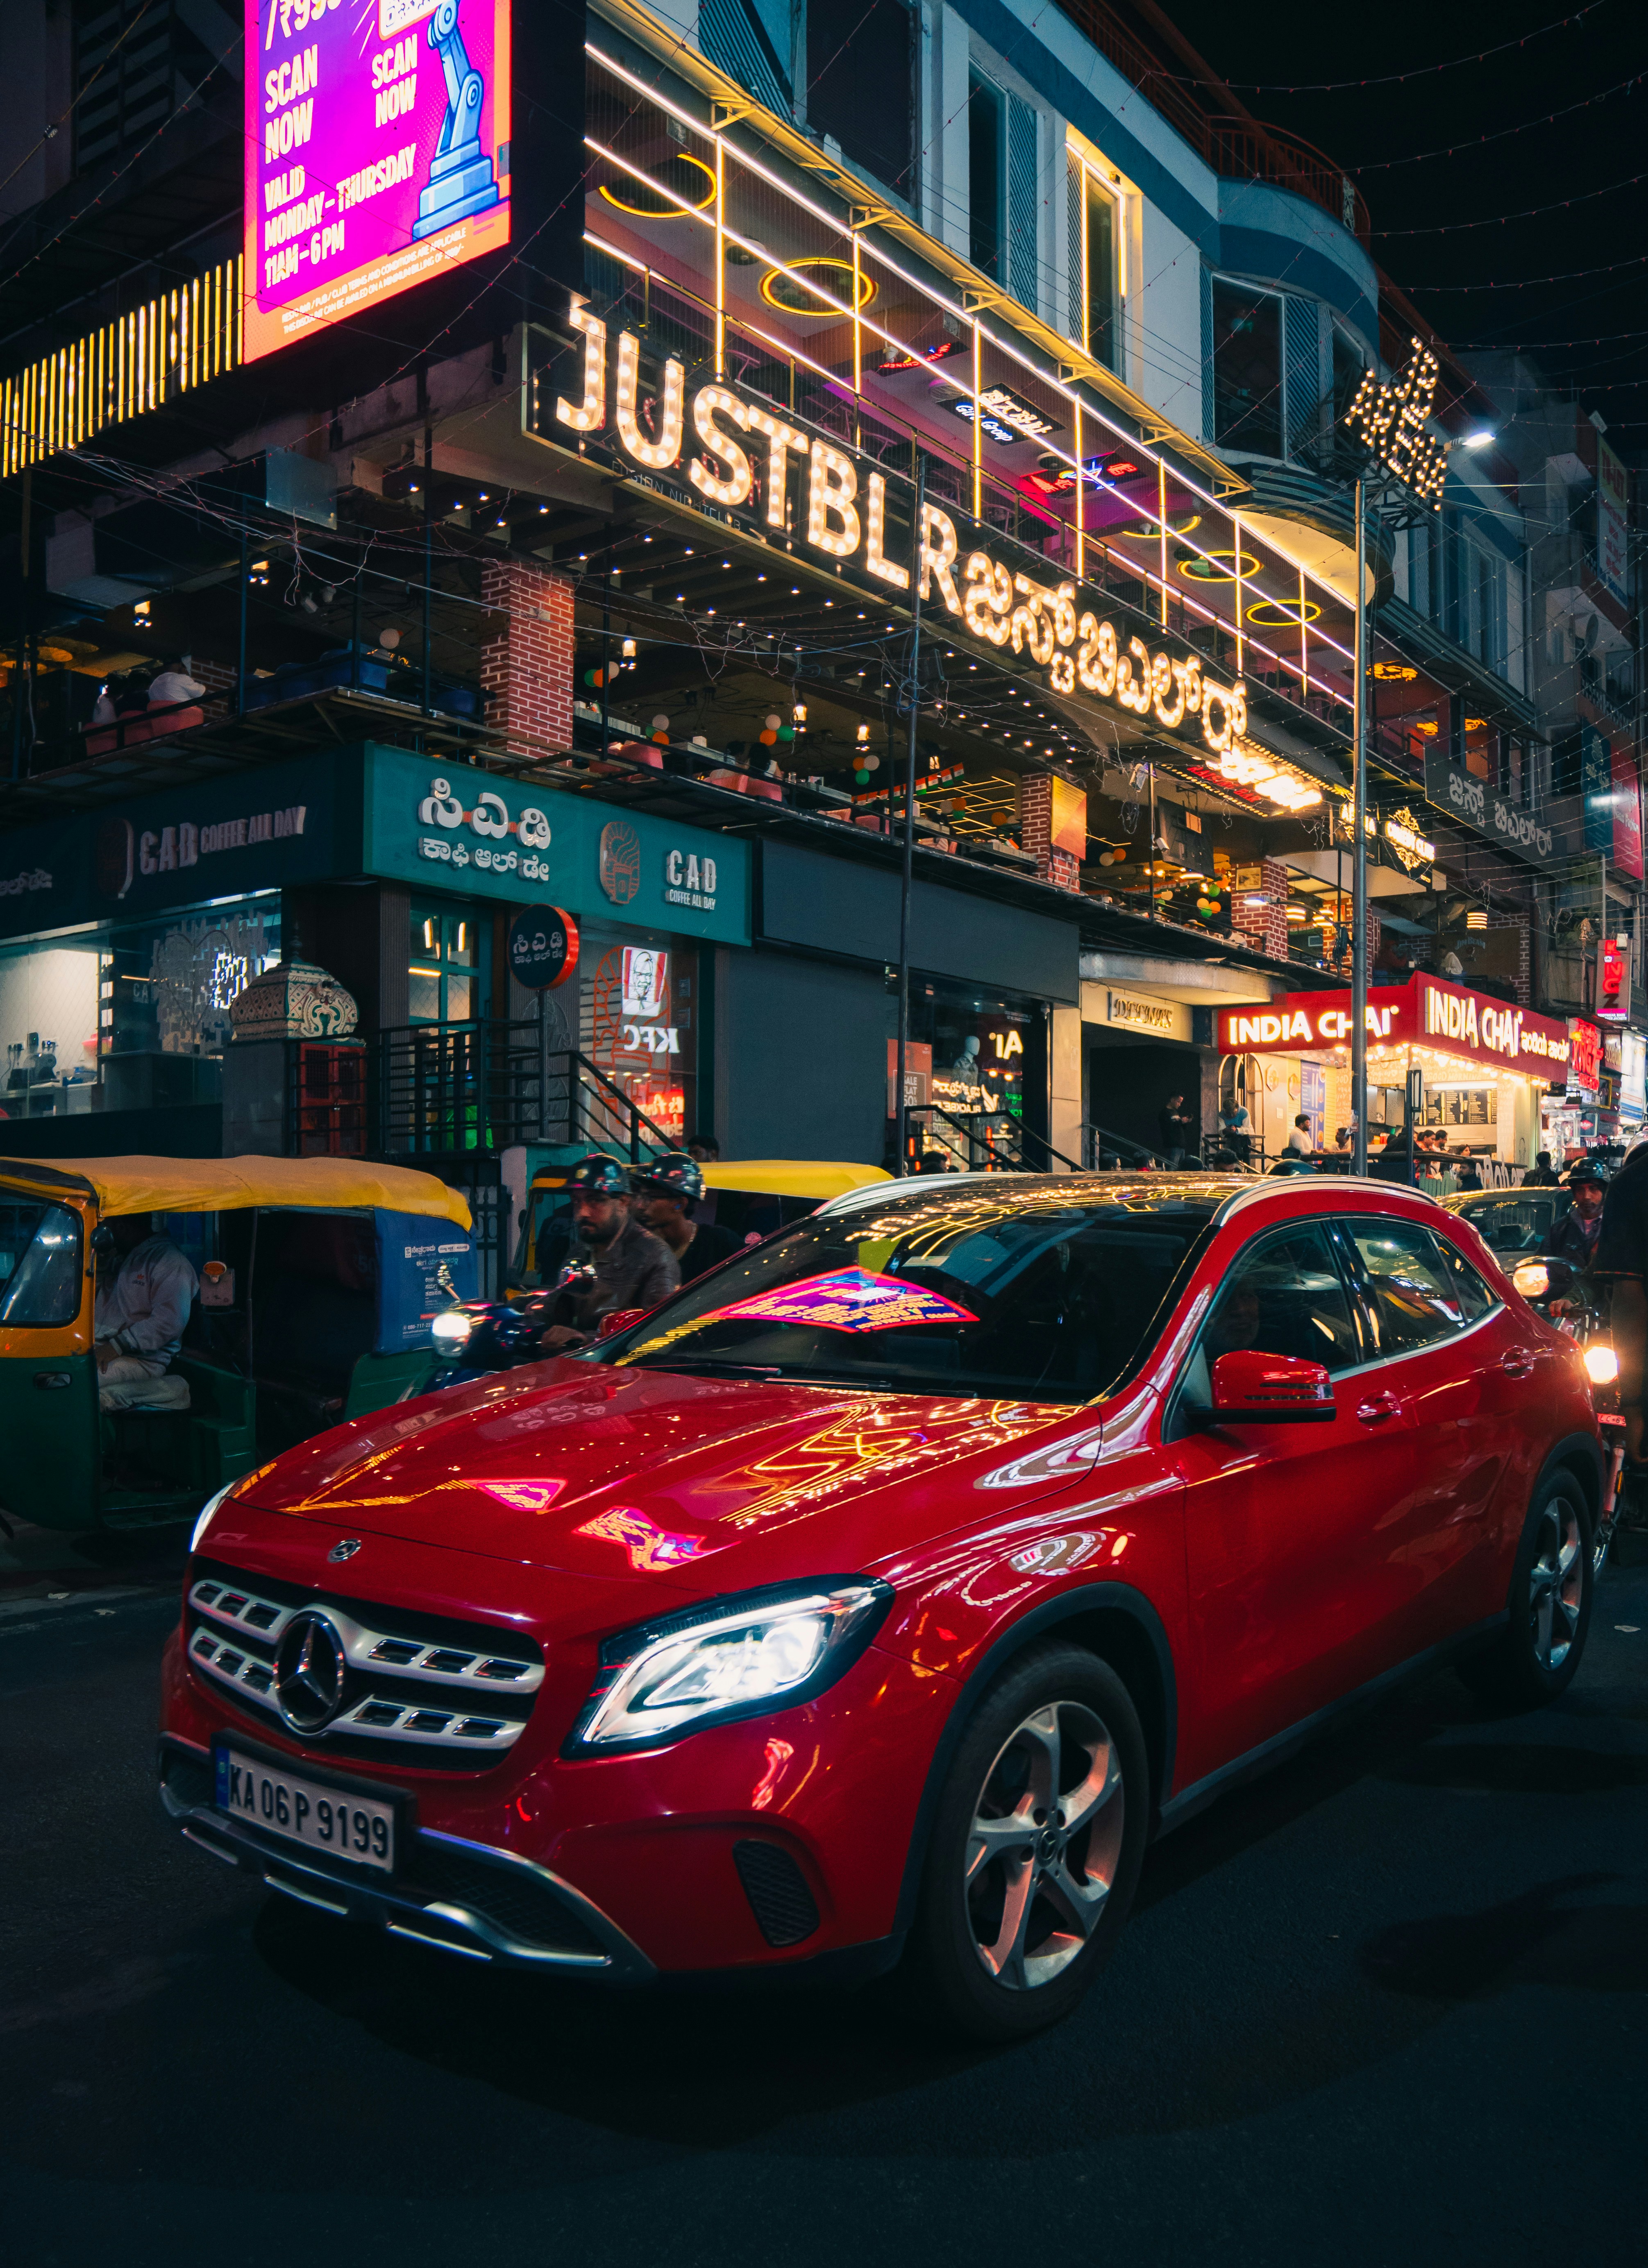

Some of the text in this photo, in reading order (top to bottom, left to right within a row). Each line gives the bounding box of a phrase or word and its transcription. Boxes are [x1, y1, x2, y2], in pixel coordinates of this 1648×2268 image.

[265, 44, 318, 114] SCAN
[372, 33, 418, 89] SCAN
[375, 74, 417, 128] NOW
[265, 98, 313, 164] NOW
[265, 166, 305, 213] VALID
[368, 269, 380, 282] AND
[417, 245, 429, 258] ARE
[981, 418, 1013, 442] Group
[200, 819, 248, 853] COFFEE
[247, 813, 274, 844] ALL
[274, 805, 306, 838] DAY
[668, 889, 716, 910] COFFEE ALL DAY
[1229, 1006, 1391, 1046] INDIA CHAI
[1426, 987, 1479, 1048] INDIA
[1480, 1007, 1519, 1058] CHAI
[230, 1763, 389, 1859] KA 06 P 9199
